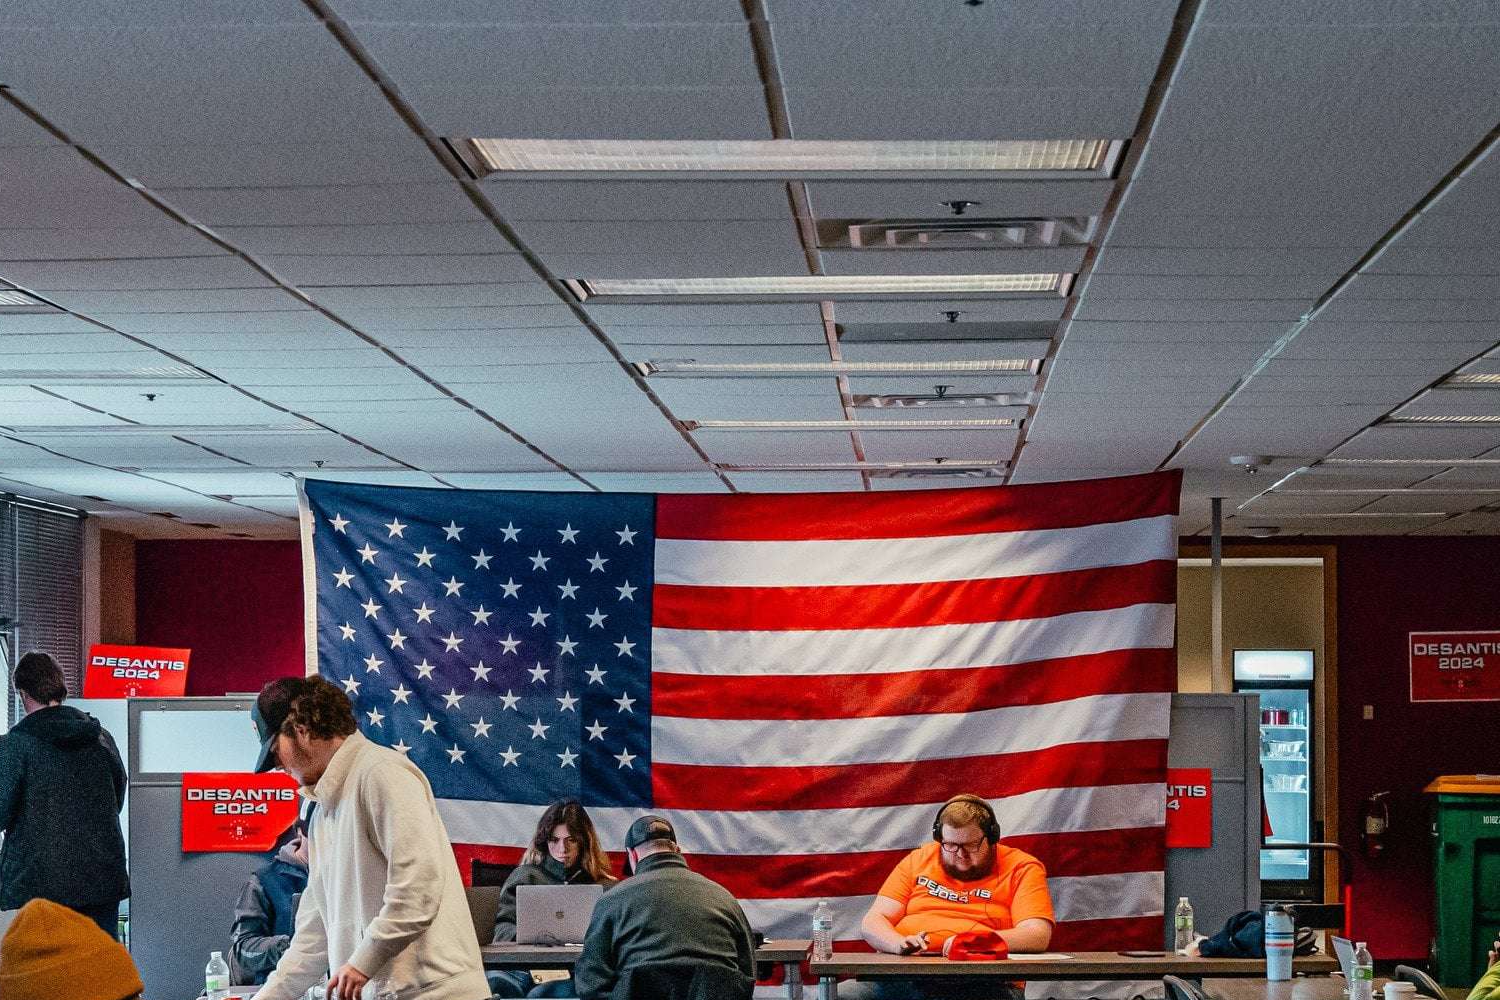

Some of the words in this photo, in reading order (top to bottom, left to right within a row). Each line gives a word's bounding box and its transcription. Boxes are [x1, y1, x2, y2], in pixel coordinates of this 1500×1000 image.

[91, 656, 185, 670] DESANTIS
[1438, 657, 1485, 669] 2024
[113, 668, 161, 680] 2024
[187, 788, 295, 801] DESANTIS
[1166, 785, 1207, 797] NTIS
[213, 802, 269, 814] 2024
[928, 887, 969, 904] 2024
